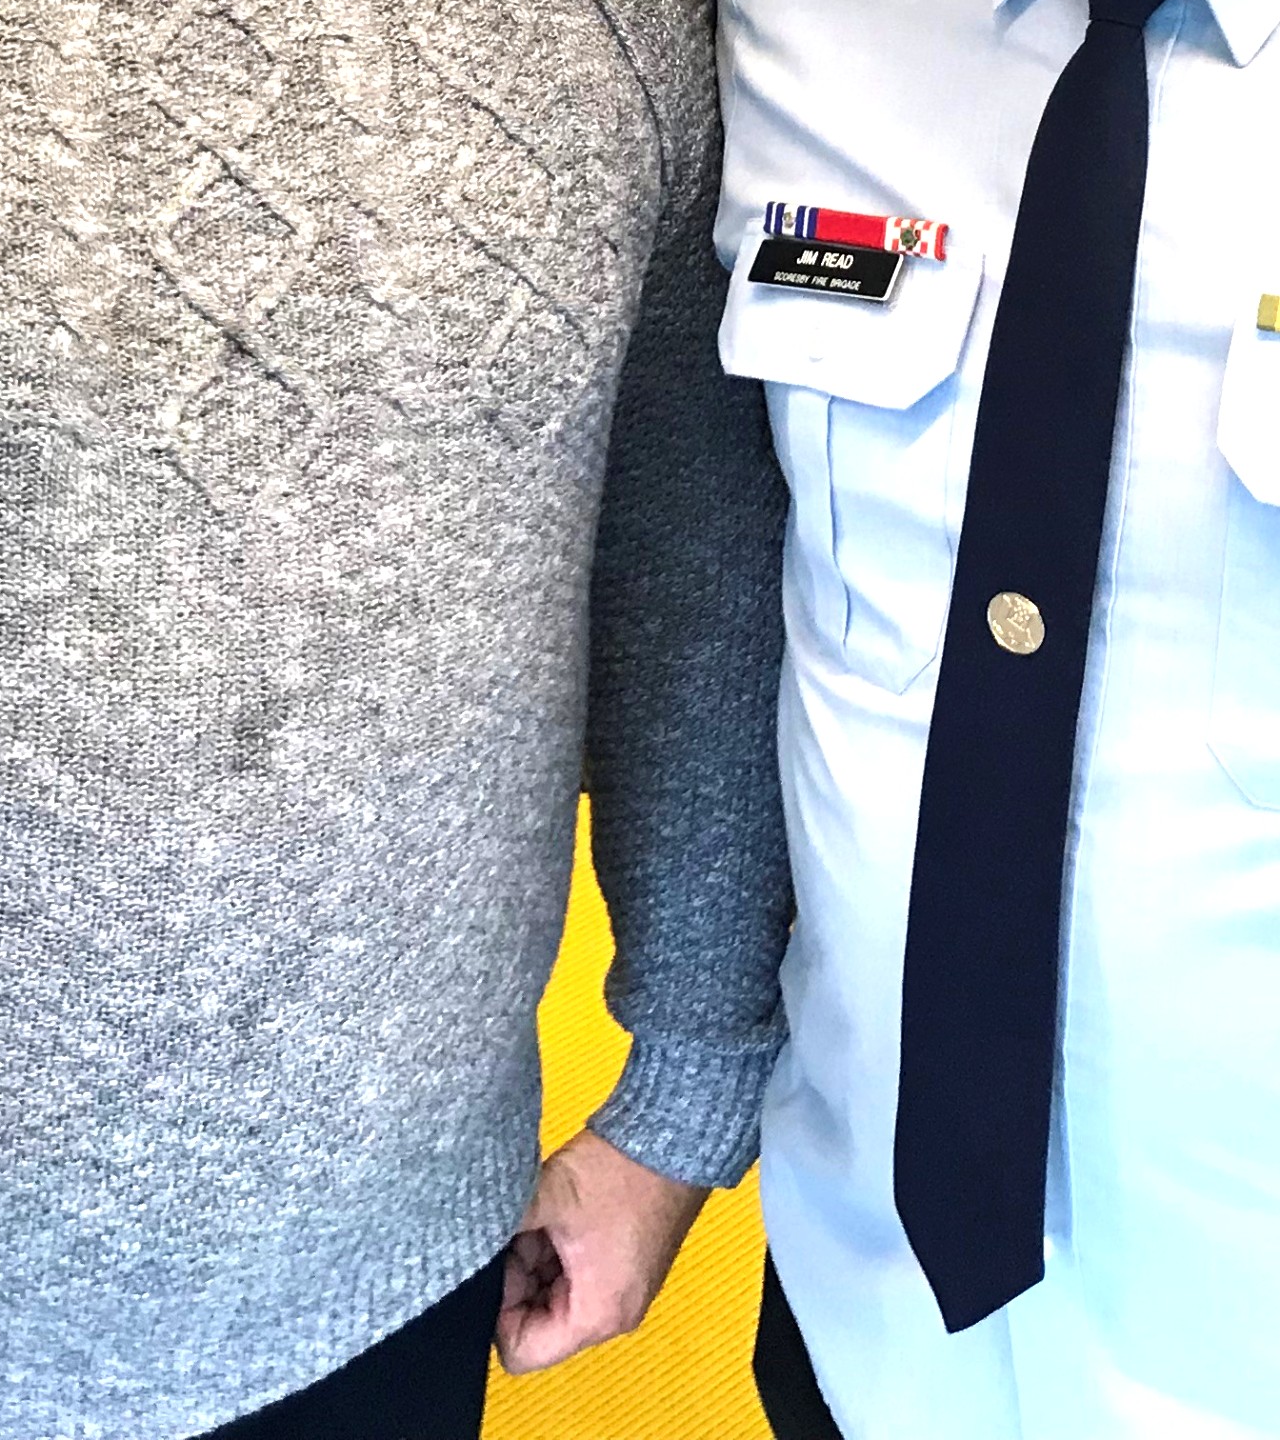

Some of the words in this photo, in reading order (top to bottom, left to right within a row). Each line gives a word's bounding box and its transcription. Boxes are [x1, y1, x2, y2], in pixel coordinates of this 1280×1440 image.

[796, 249, 818, 265] JIM
[821, 252, 854, 269] READ
[774, 271, 810, 284] SCORESBY
[812, 275, 829, 286] FIRE
[830, 278, 862, 291] BRIGADE
